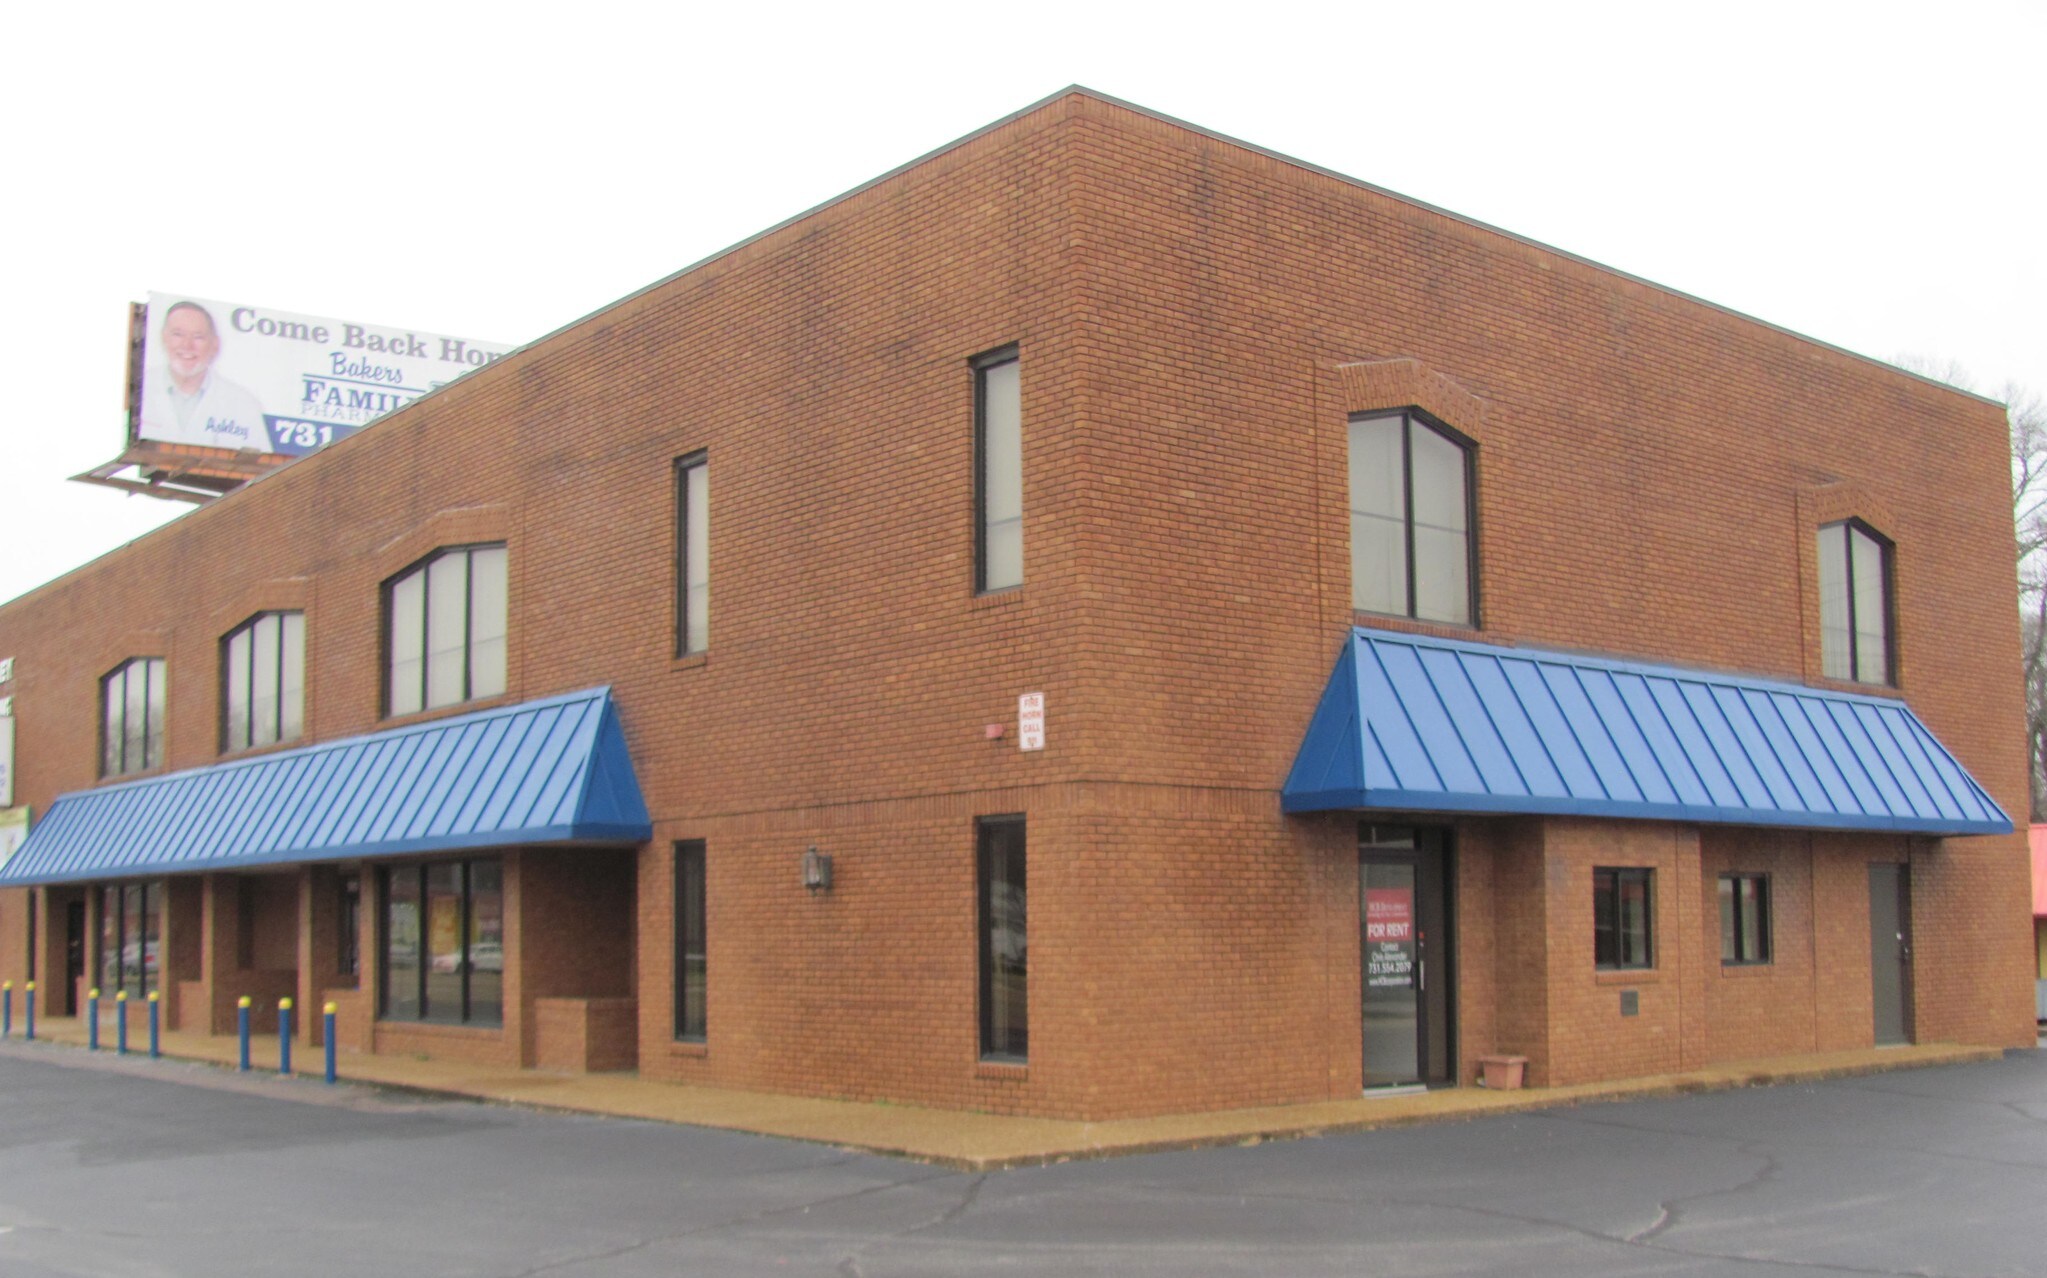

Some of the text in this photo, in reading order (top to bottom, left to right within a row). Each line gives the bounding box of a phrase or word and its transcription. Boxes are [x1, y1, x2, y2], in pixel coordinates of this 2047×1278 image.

[231, 307, 329, 343] Come
[342, 324, 427, 358] Back
[330, 352, 403, 383] Bakers
[302, 379, 417, 411] FAMIL
[205, 416, 249, 440] Ashley
[275, 420, 333, 447] 731
[1023, 697, 1040, 707] FIRE
[1023, 724, 1040, 733] CALL
[1367, 922, 1409, 938] FOR RENT
